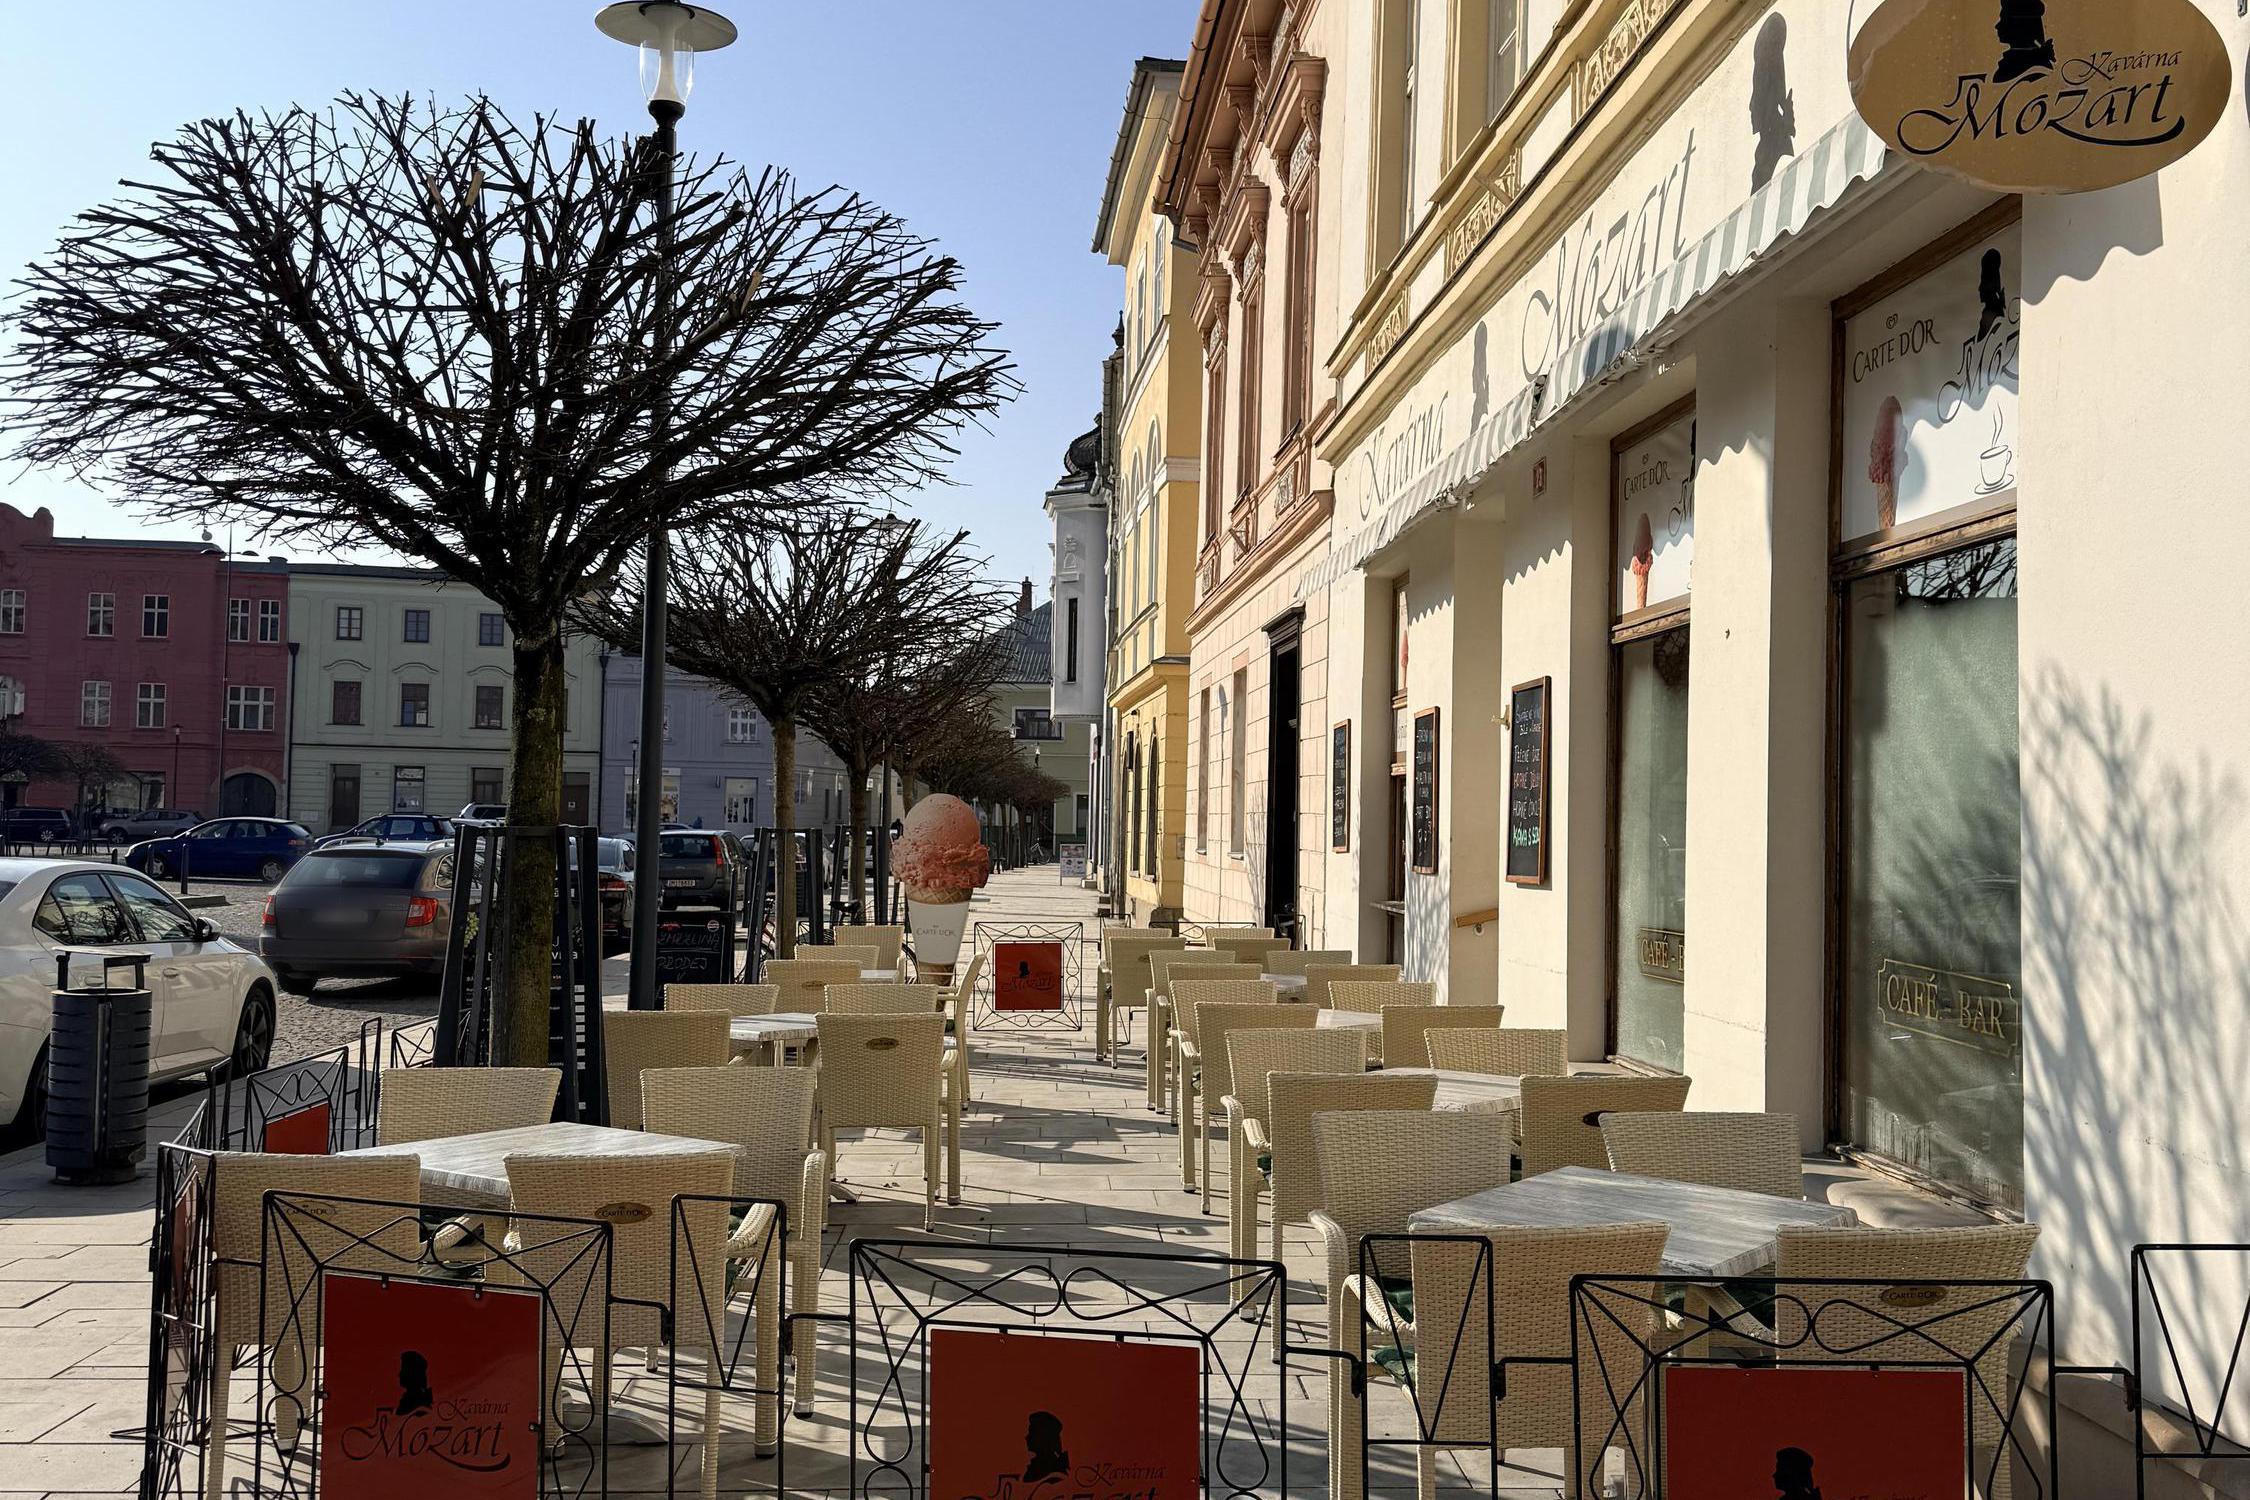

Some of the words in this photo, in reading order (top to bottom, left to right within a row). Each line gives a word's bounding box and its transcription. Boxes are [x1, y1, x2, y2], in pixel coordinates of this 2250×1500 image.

[2062, 51, 2183, 85] Kavárna
[1897, 72, 2185, 155] Mozart
[1522, 128, 1696, 382] Mozart
[1853, 338, 1894, 383] CARTE
[1900, 318, 1941, 357] D'OR
[1624, 470, 1647, 501] CARTE
[1649, 460, 1671, 486] D'OR
[1642, 935, 1669, 968] CAFÉ
[1886, 973, 1940, 1020] CAFÉ
[1958, 989, 2005, 1040] BAR
[437, 1398, 511, 1421] Kavárna
[341, 1407, 512, 1472] Mozart
[1075, 1462, 1167, 1488] Kavárna
